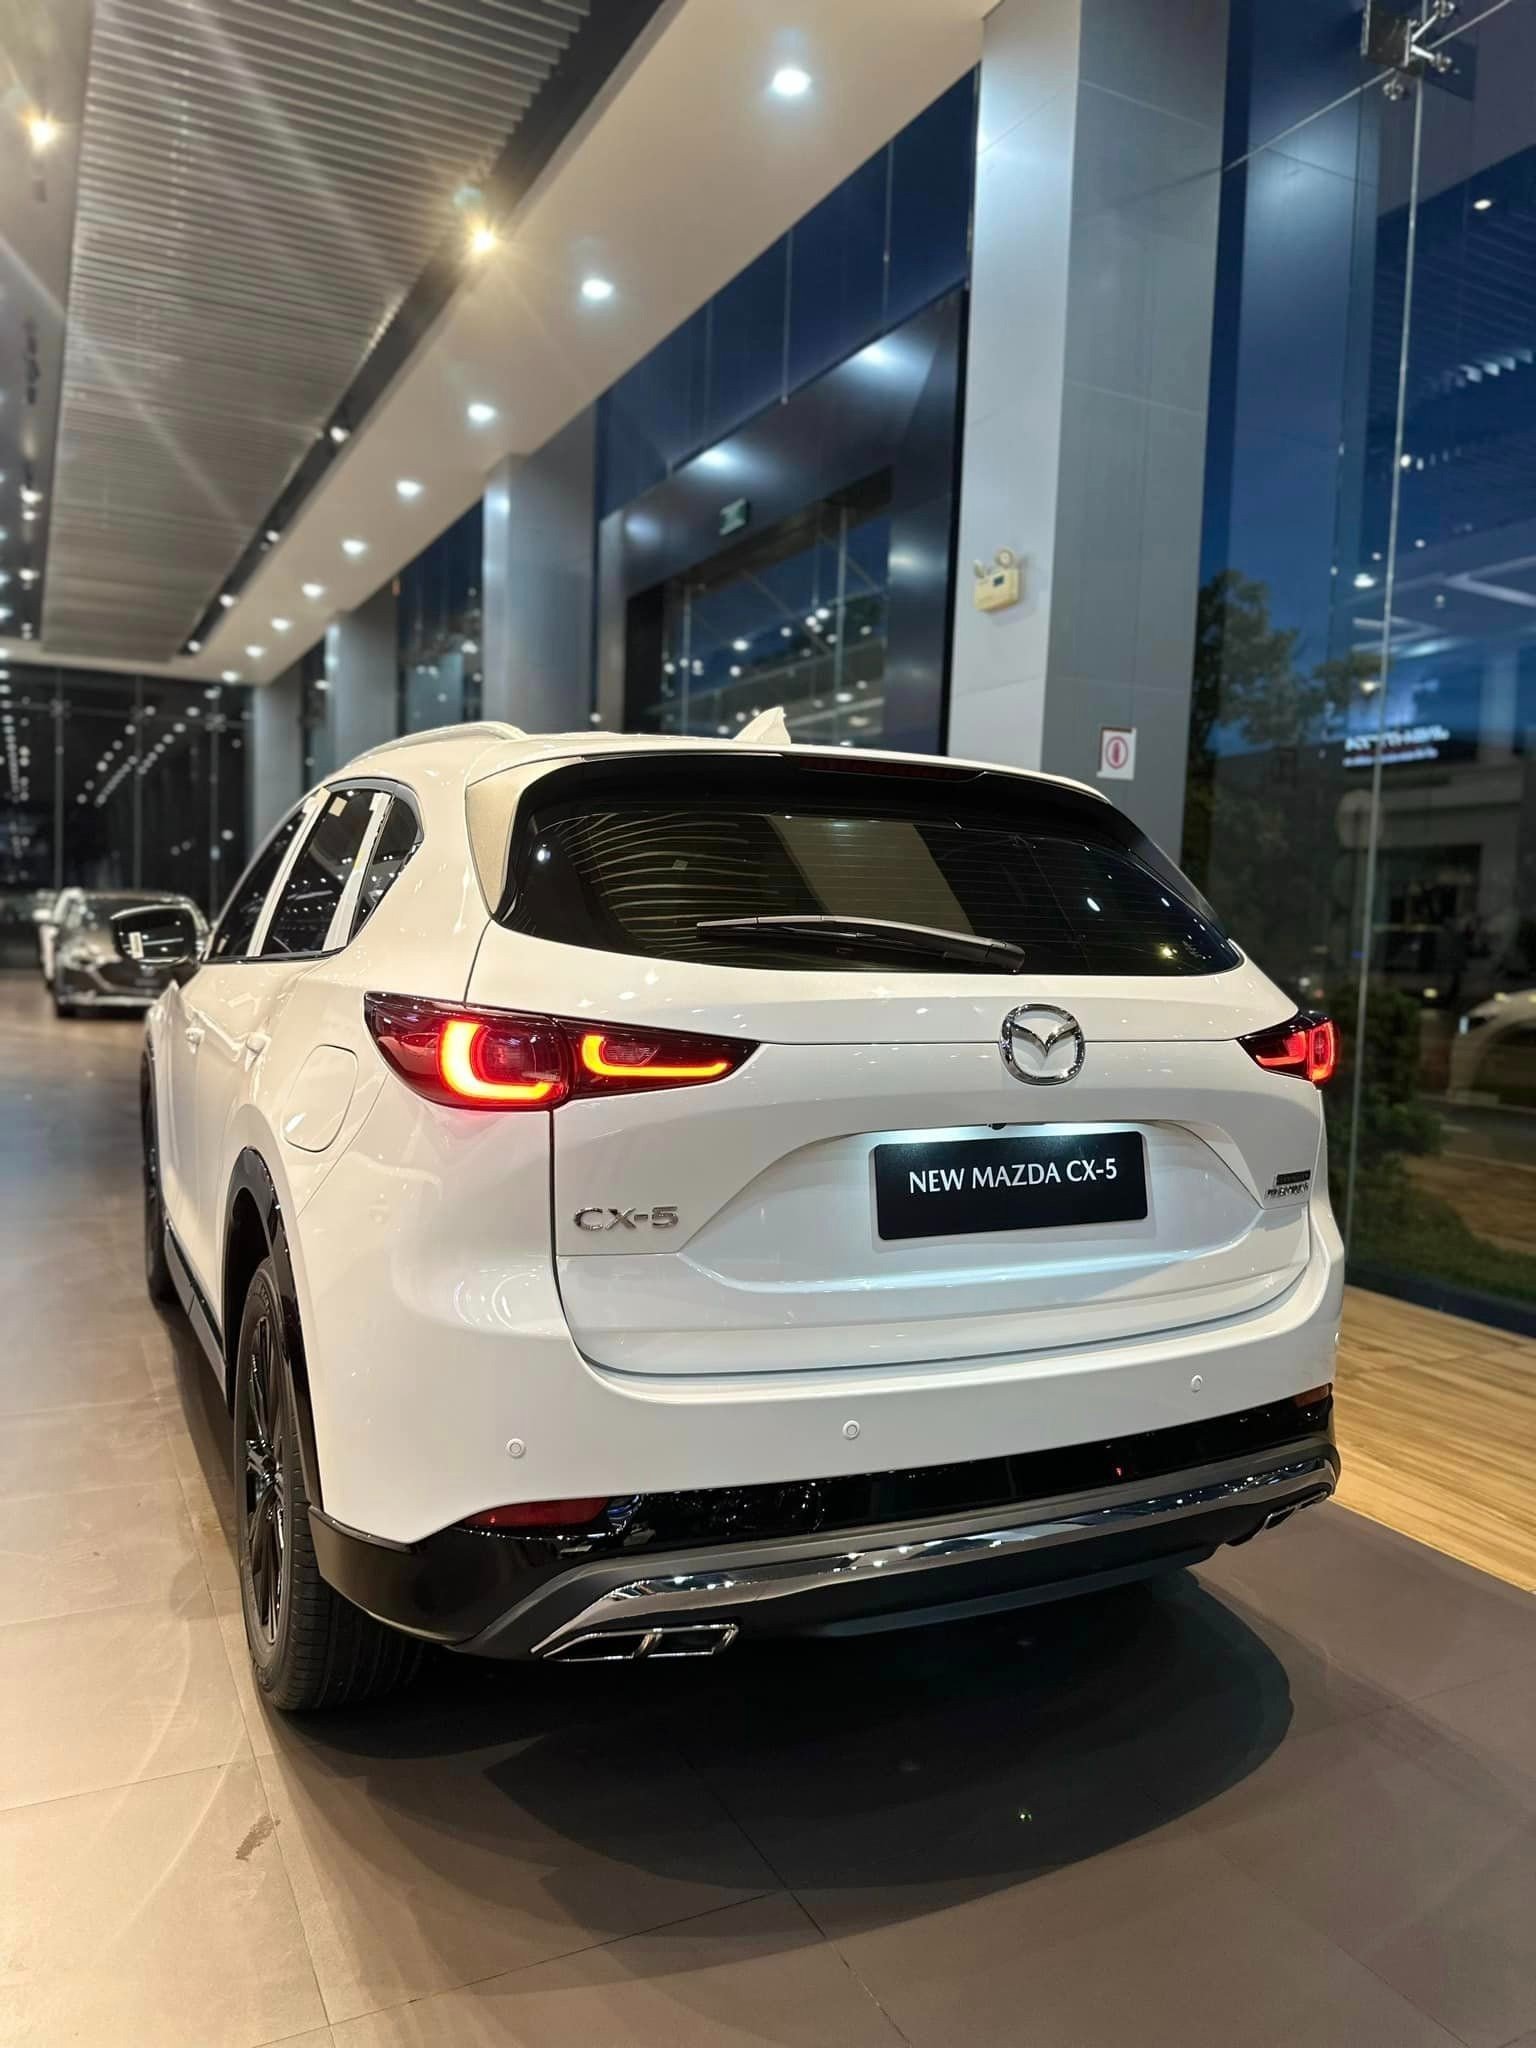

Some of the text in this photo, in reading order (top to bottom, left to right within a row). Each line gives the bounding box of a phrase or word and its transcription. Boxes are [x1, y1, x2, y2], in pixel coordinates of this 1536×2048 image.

[909, 1158, 1118, 1194] NEW MAZDA CX-5
[574, 1206, 679, 1231] CX-5
